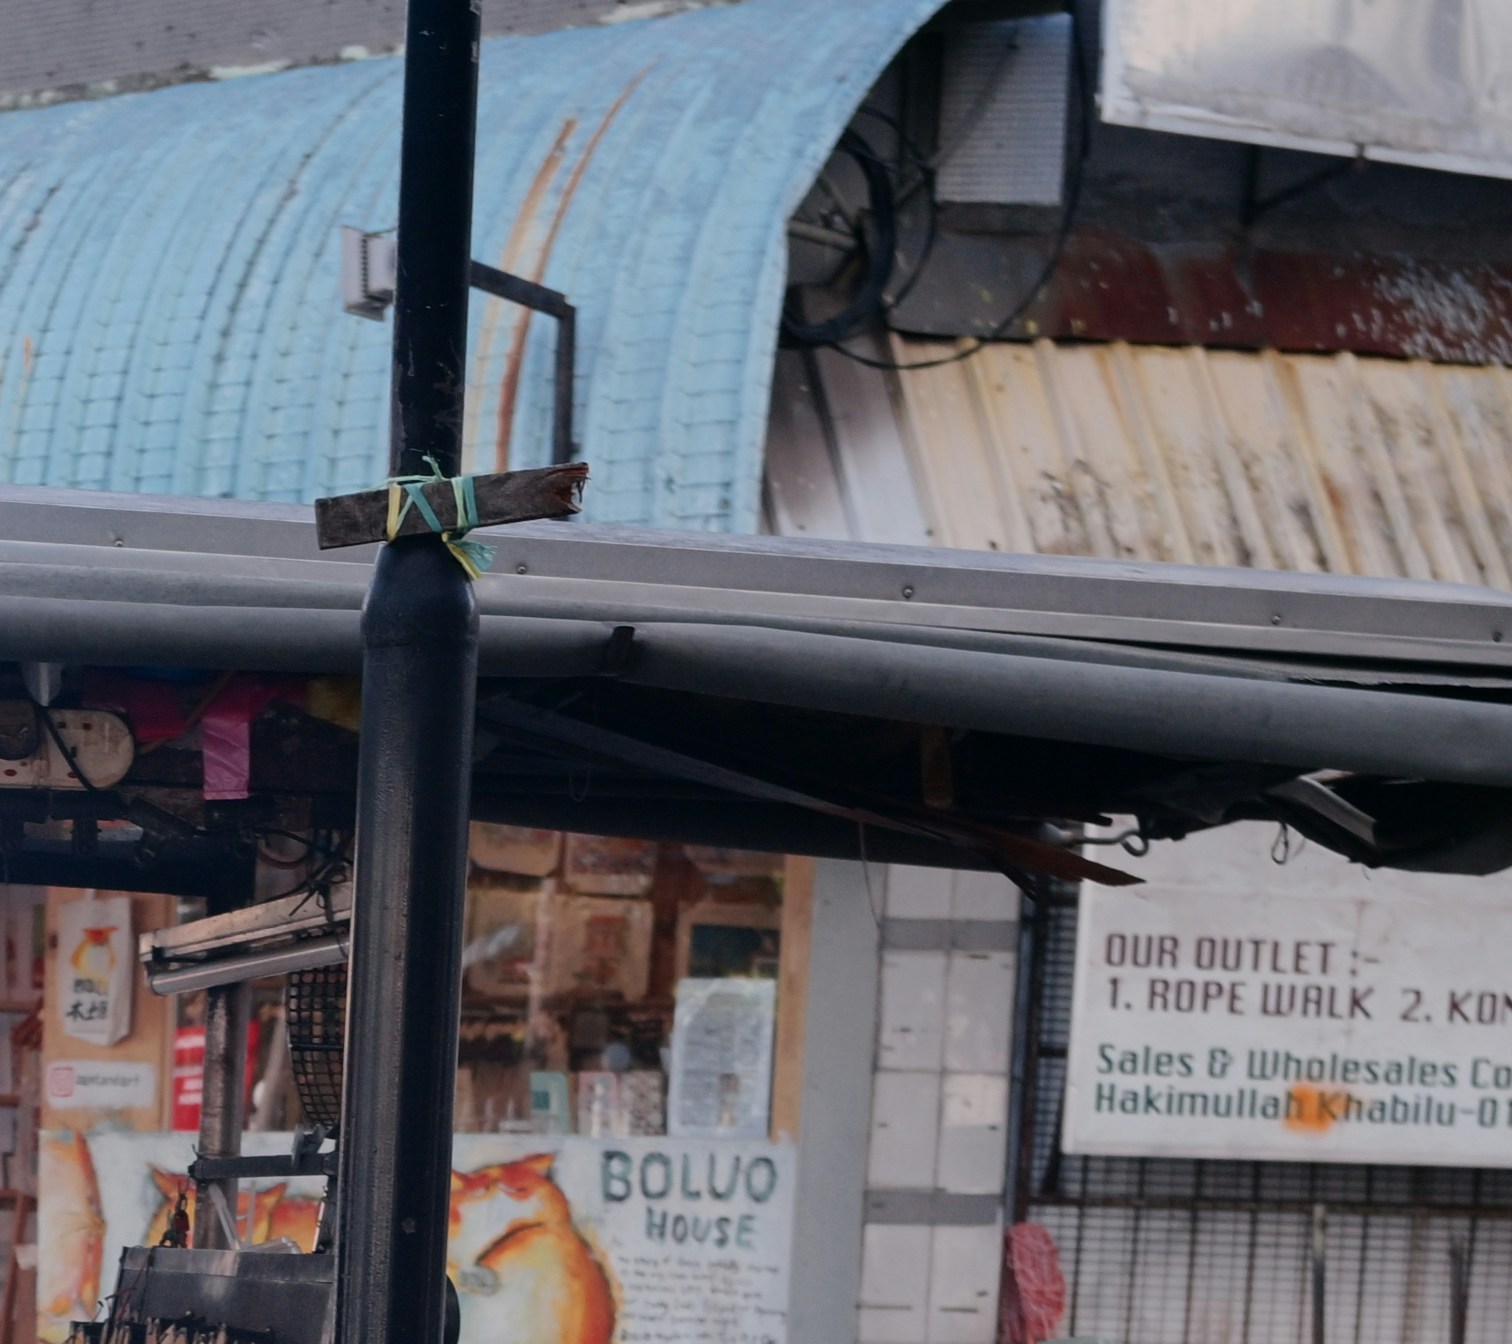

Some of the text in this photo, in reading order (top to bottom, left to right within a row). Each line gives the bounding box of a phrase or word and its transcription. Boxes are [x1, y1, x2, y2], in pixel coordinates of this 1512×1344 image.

[1105, 933, 1180, 969] OUR
[1194, 937, 1337, 975] OUTLET
[1107, 977, 1133, 1011] 1.
[1147, 978, 1247, 1015] ROPE
[1261, 982, 1375, 1020] WALK
[1400, 988, 1433, 1023] 2.
[1097, 1043, 1194, 1079] Sales
[1207, 1048, 1233, 1078] &
[1247, 1049, 1458, 1089] Wholesales
[1095, 1083, 1303, 1121] Hakimullah
[600, 1150, 777, 1203] BOLUO
[645, 1204, 756, 1249] HOUSE
